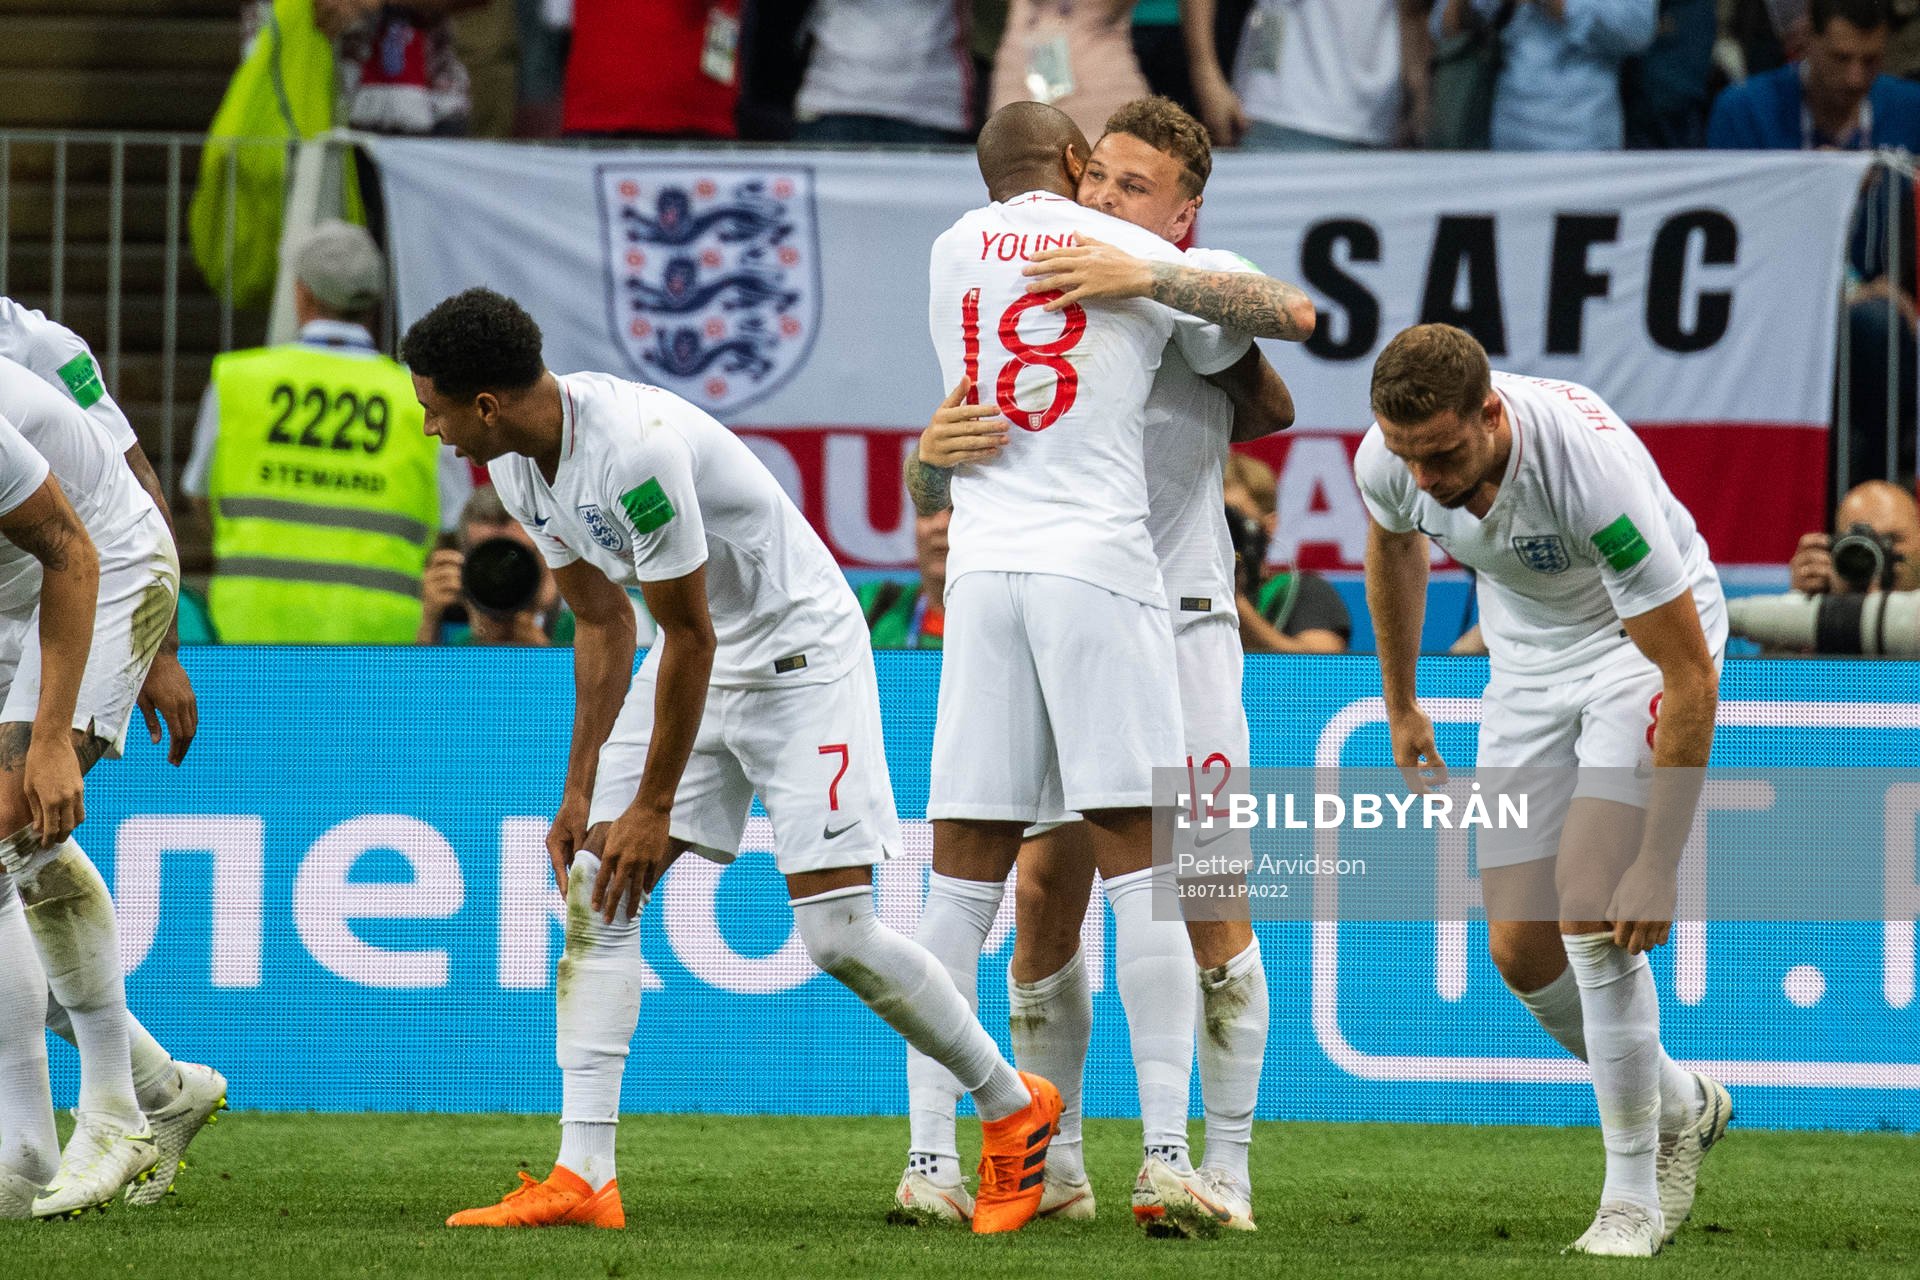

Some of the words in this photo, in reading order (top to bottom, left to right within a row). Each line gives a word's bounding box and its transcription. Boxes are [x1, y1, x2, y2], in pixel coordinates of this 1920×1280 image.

[980, 230, 1074, 261] YOUN
[1300, 209, 1738, 361] SAFC
[961, 287, 1087, 432] 18
[267, 384, 389, 454] 2229
[260, 465, 386, 492] STEWARD
[818, 743, 849, 811] 7
[1186, 752, 1232, 821] 12
